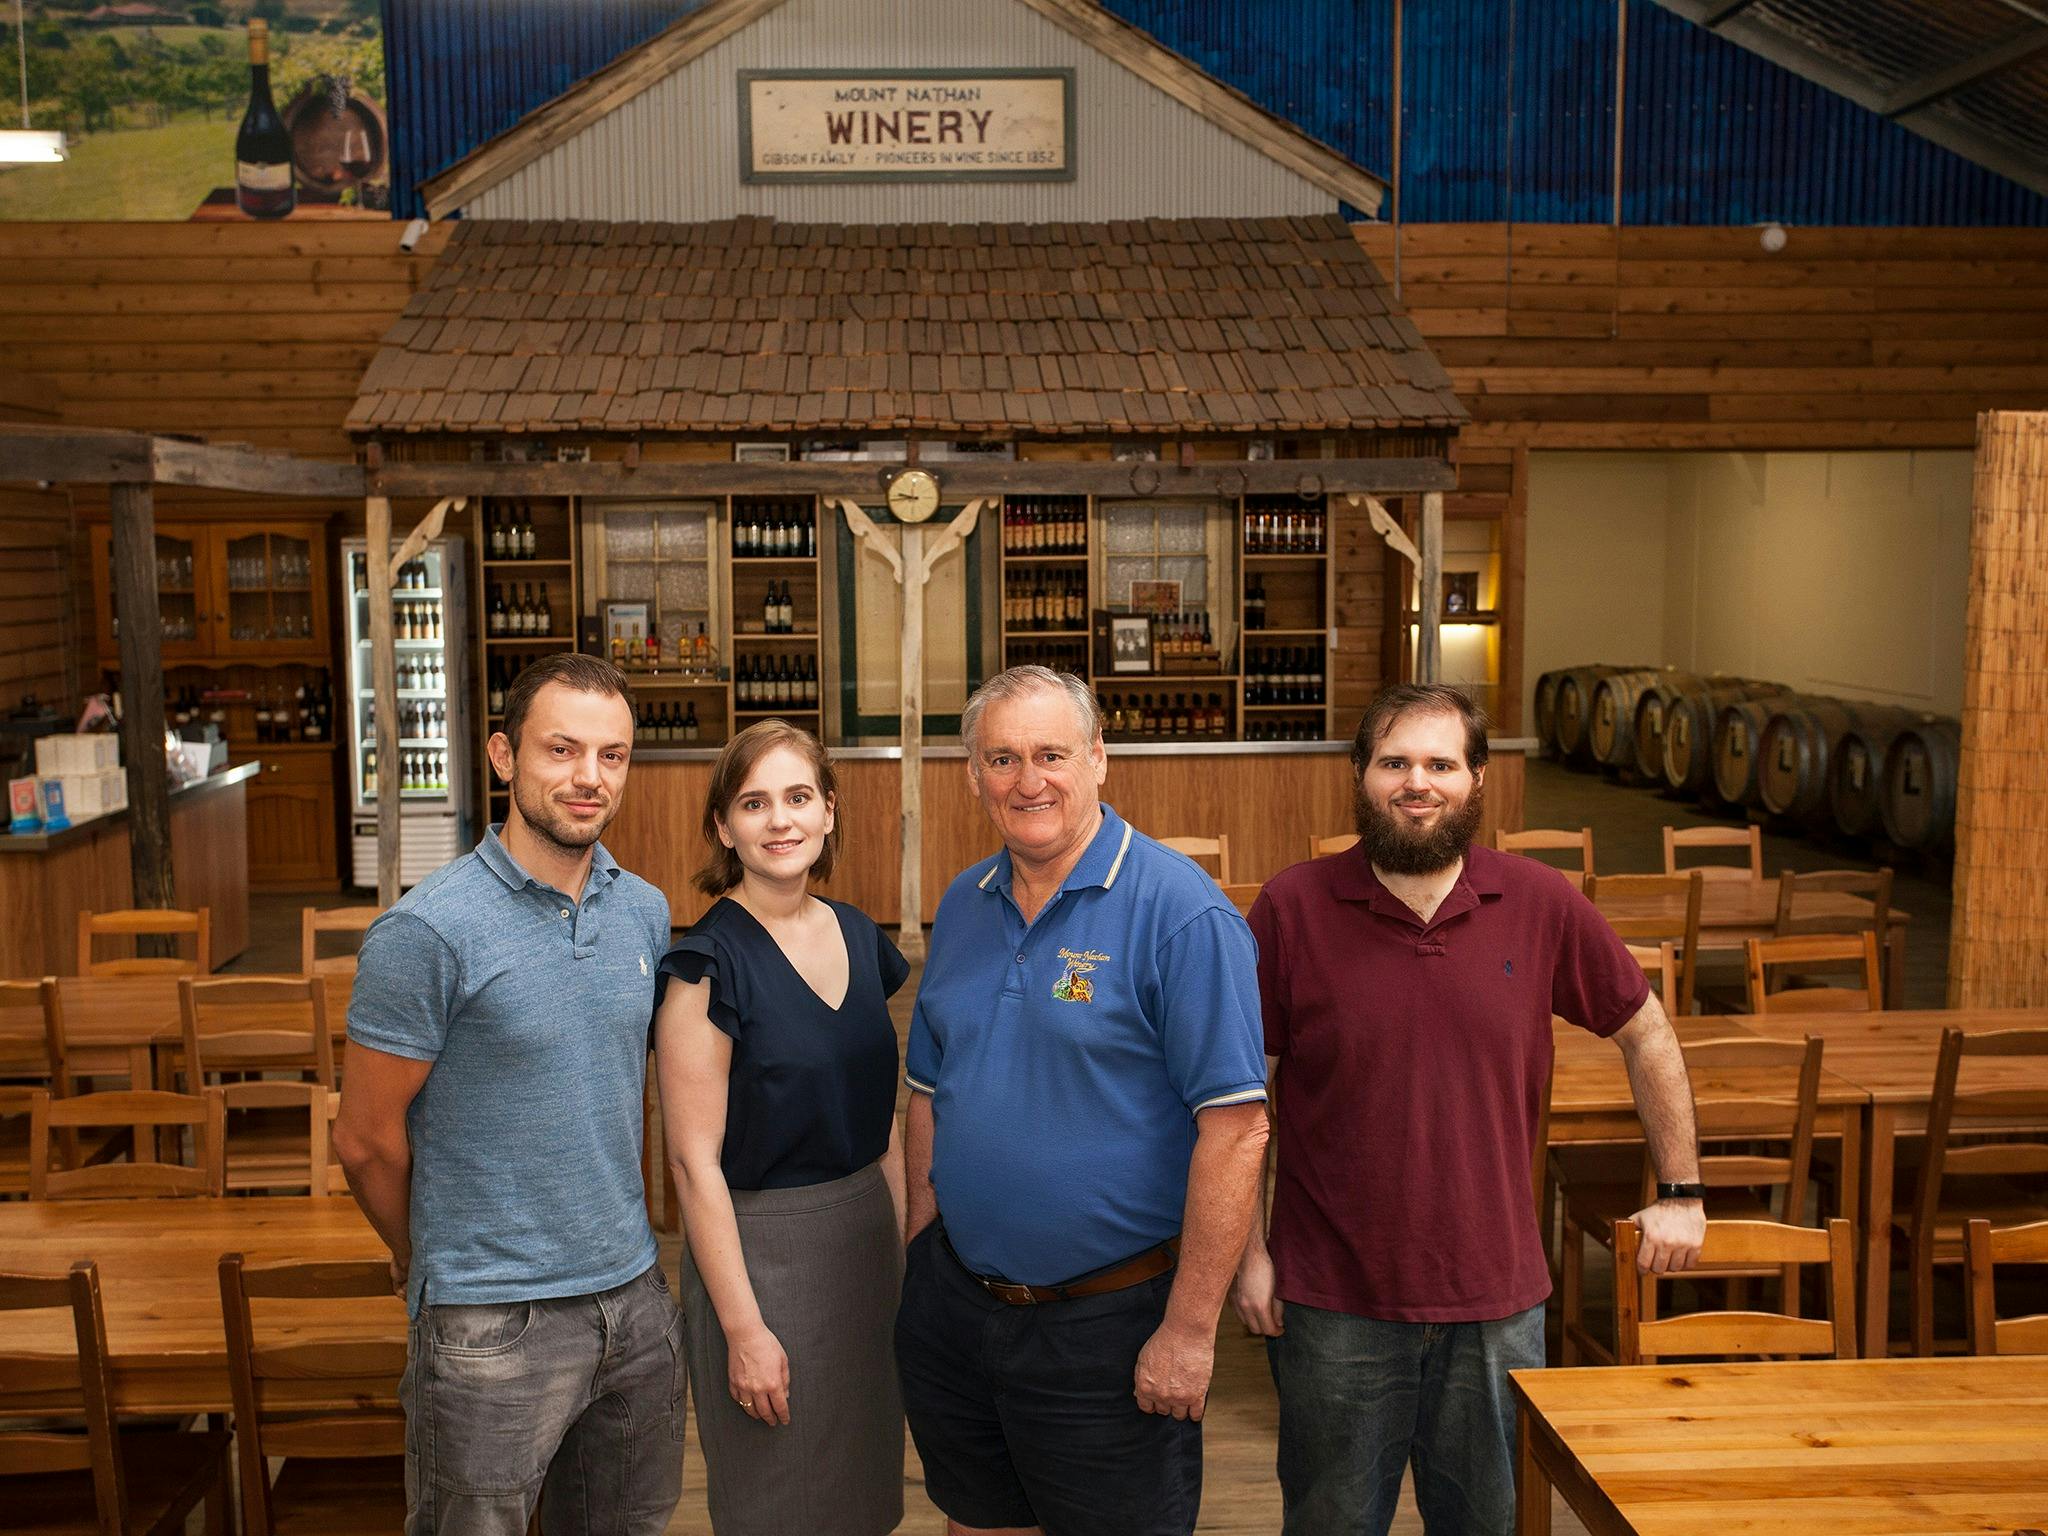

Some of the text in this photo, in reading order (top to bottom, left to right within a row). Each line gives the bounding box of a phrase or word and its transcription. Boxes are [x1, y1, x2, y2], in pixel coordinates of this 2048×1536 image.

[834, 86, 981, 102] MOUNT NATHAN
[825, 109, 993, 145] WINERY
[762, 150, 1056, 166] GIBSON FAMILY PIONEERS IN WINE SINCE 1852
